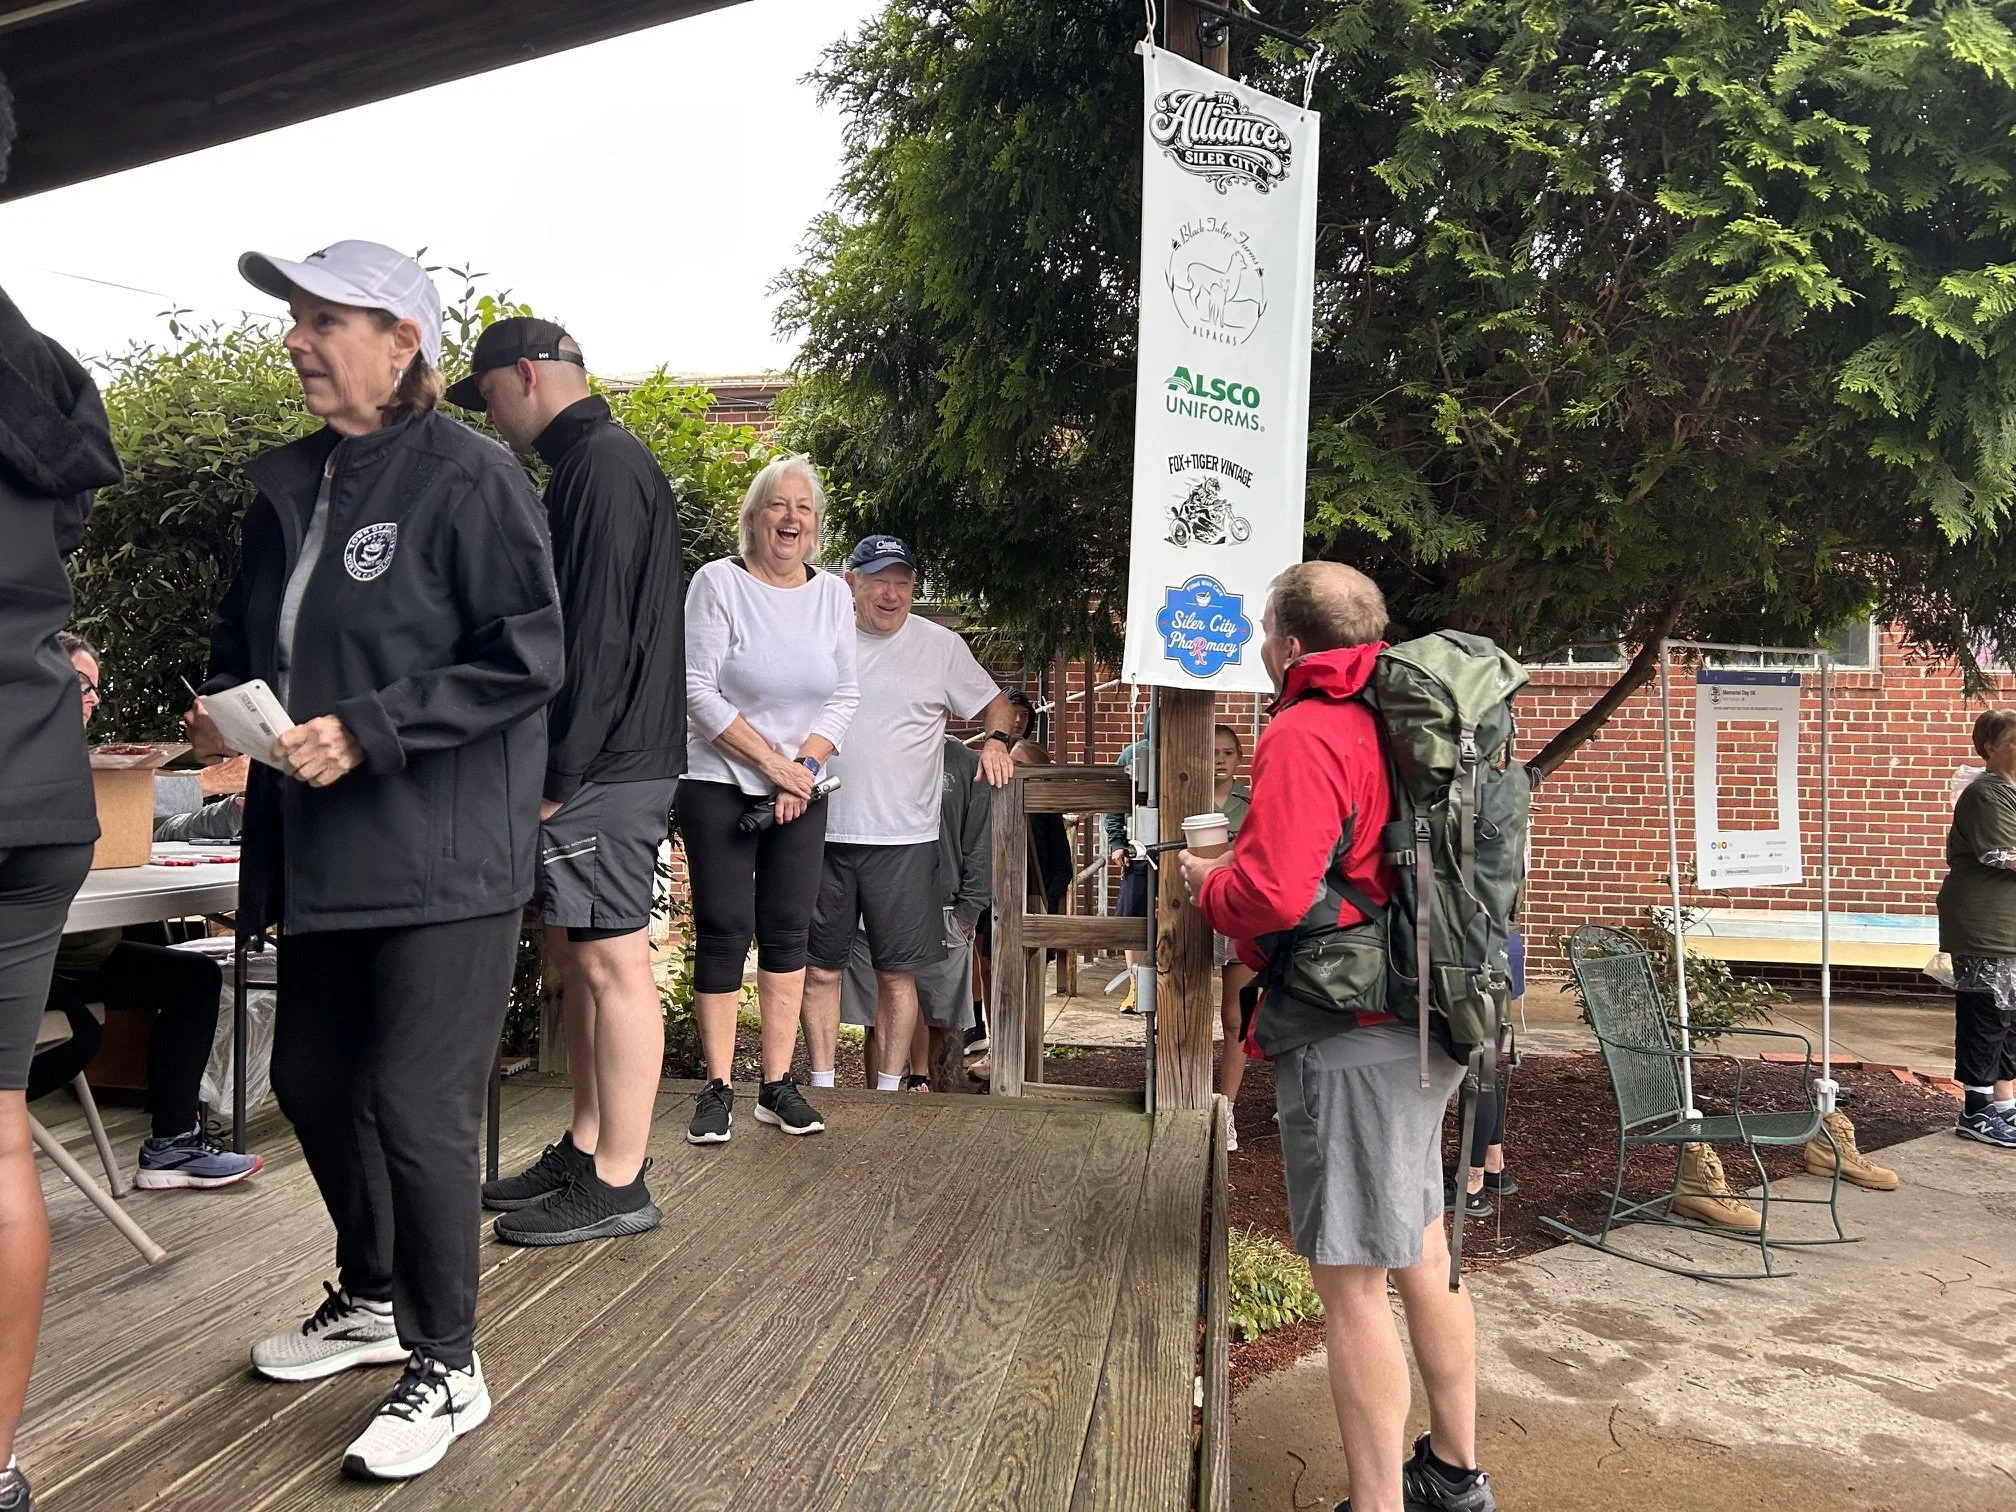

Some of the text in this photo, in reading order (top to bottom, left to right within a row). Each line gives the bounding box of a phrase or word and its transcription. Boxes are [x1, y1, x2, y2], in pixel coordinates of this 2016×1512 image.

[1217, 94, 1235, 106] THE
[1149, 89, 1290, 150] Alliance
[1185, 150, 1260, 174] SILER CITY
[1180, 217, 1259, 265] Black Tulip Farms
[1192, 325, 1237, 346] ALPACAS
[1166, 365, 1260, 409] ALSCO
[1166, 394, 1260, 431] UNIFORMS
[1220, 457, 1253, 488] VINTAGE
[348, 528, 370, 549] TOWN
[1171, 610, 1237, 638] Siler City
